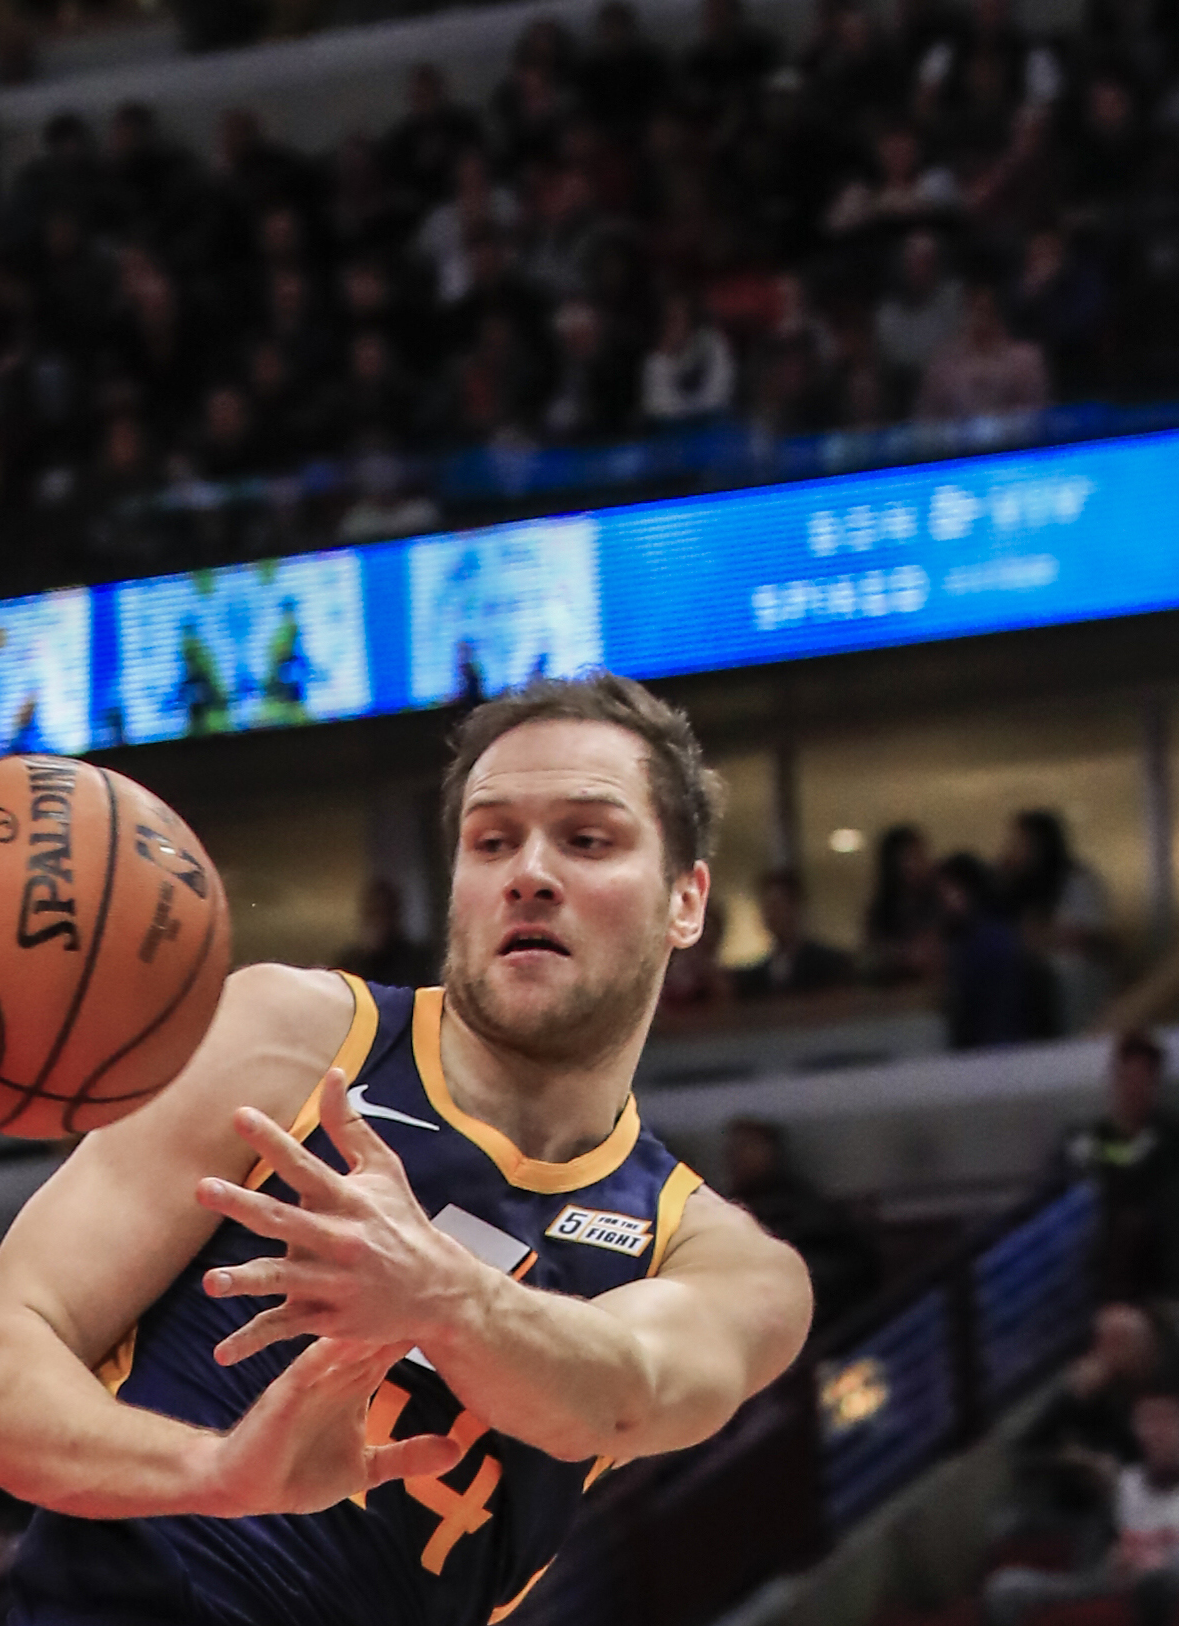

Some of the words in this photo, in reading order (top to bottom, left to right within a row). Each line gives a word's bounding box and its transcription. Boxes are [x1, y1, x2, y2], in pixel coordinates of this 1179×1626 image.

[16, 757, 81, 951] SPALDIN
[559, 1212, 587, 1234] 5
[598, 1217, 618, 1225] FOR
[621, 1221, 640, 1229] THE
[586, 1228, 641, 1248] FIGHT
